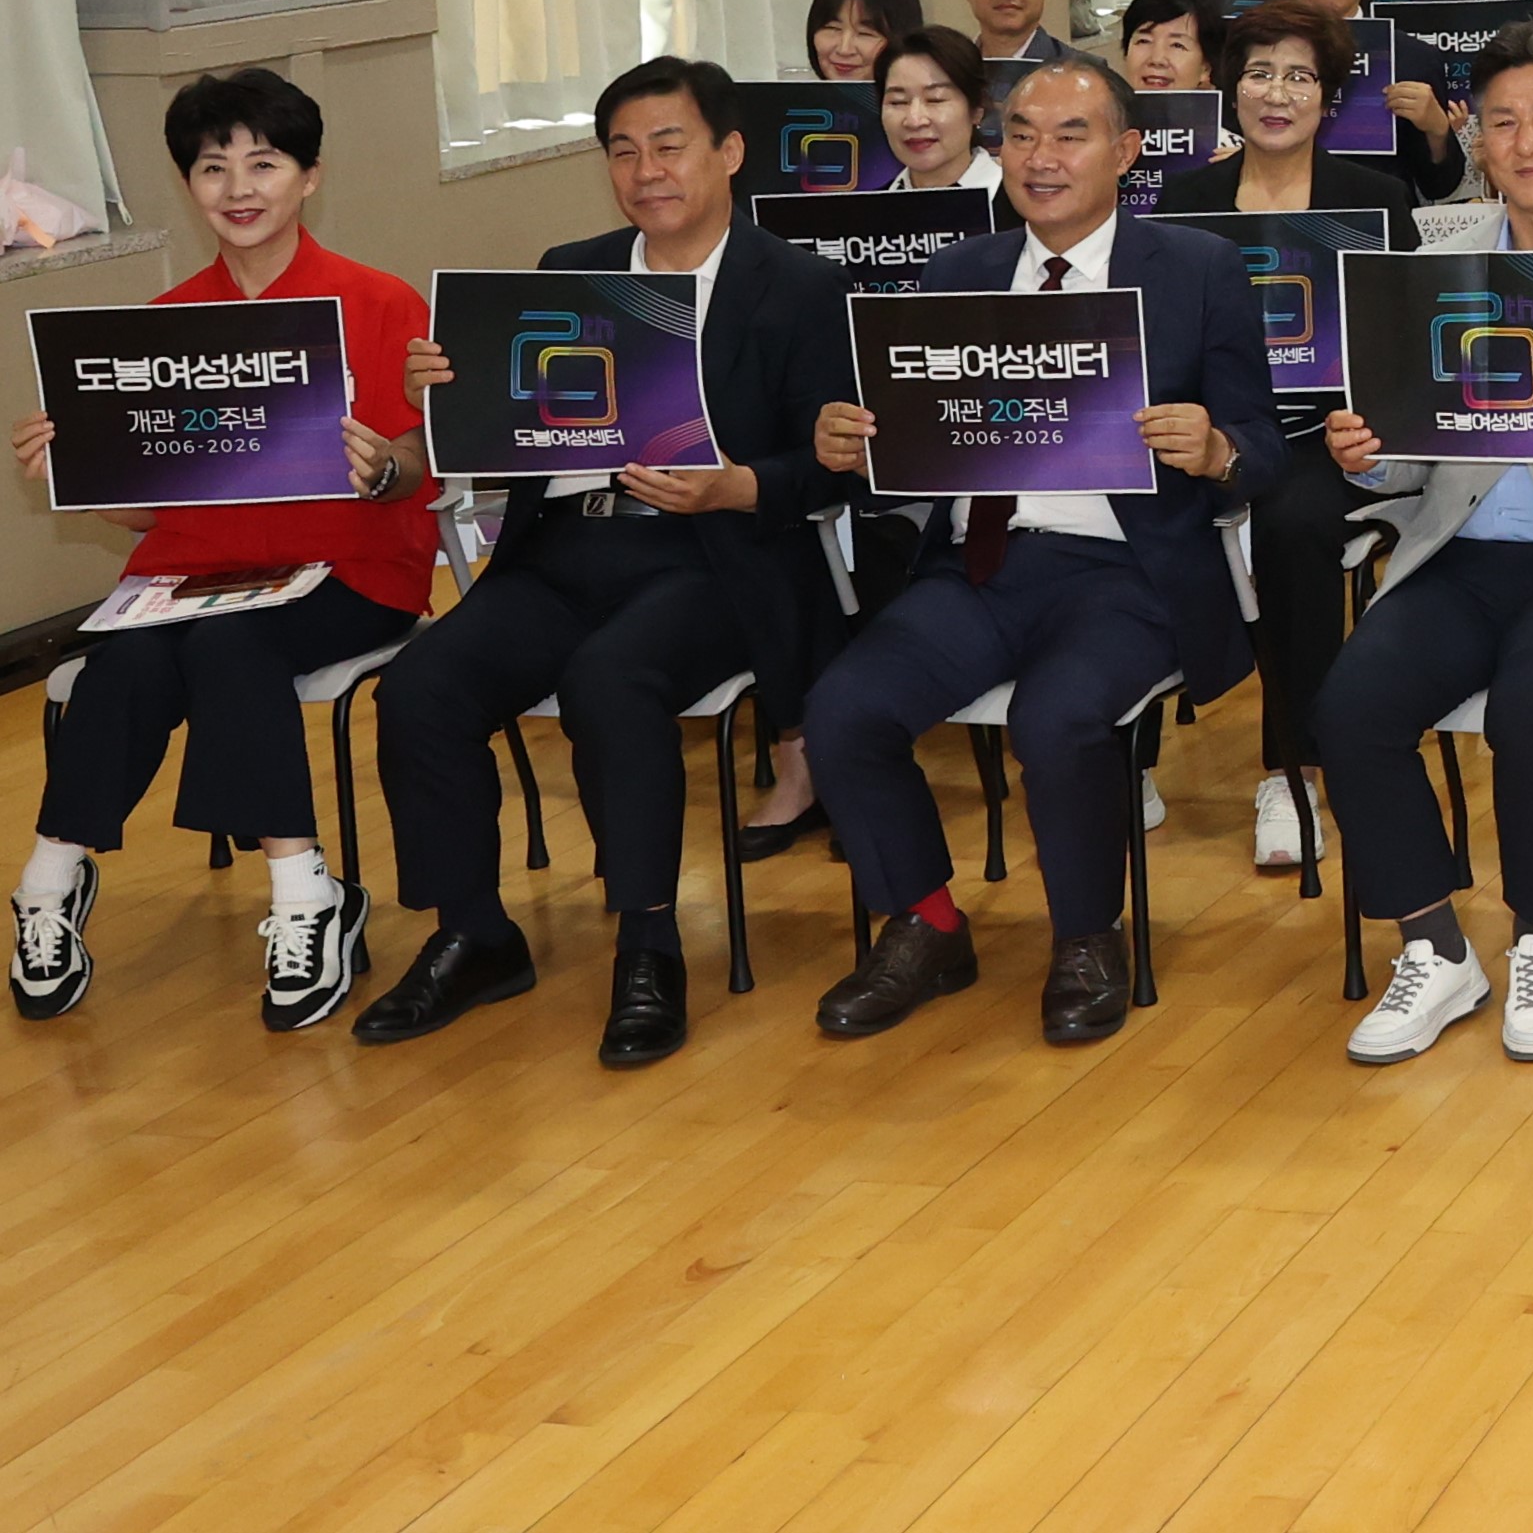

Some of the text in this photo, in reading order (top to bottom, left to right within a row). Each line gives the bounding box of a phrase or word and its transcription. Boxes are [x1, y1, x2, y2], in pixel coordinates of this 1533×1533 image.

[74, 350, 309, 392] 도봉여성센터
[888, 342, 1109, 380] 도봉여성센터
[126, 406, 267, 434] 개관 20주년
[937, 397, 1069, 423] 개관 20주년
[142, 438, 261, 456] 2006-2026
[513, 428, 626, 448] 도봉여성센터
[951, 429, 1064, 445] 2006-2026
